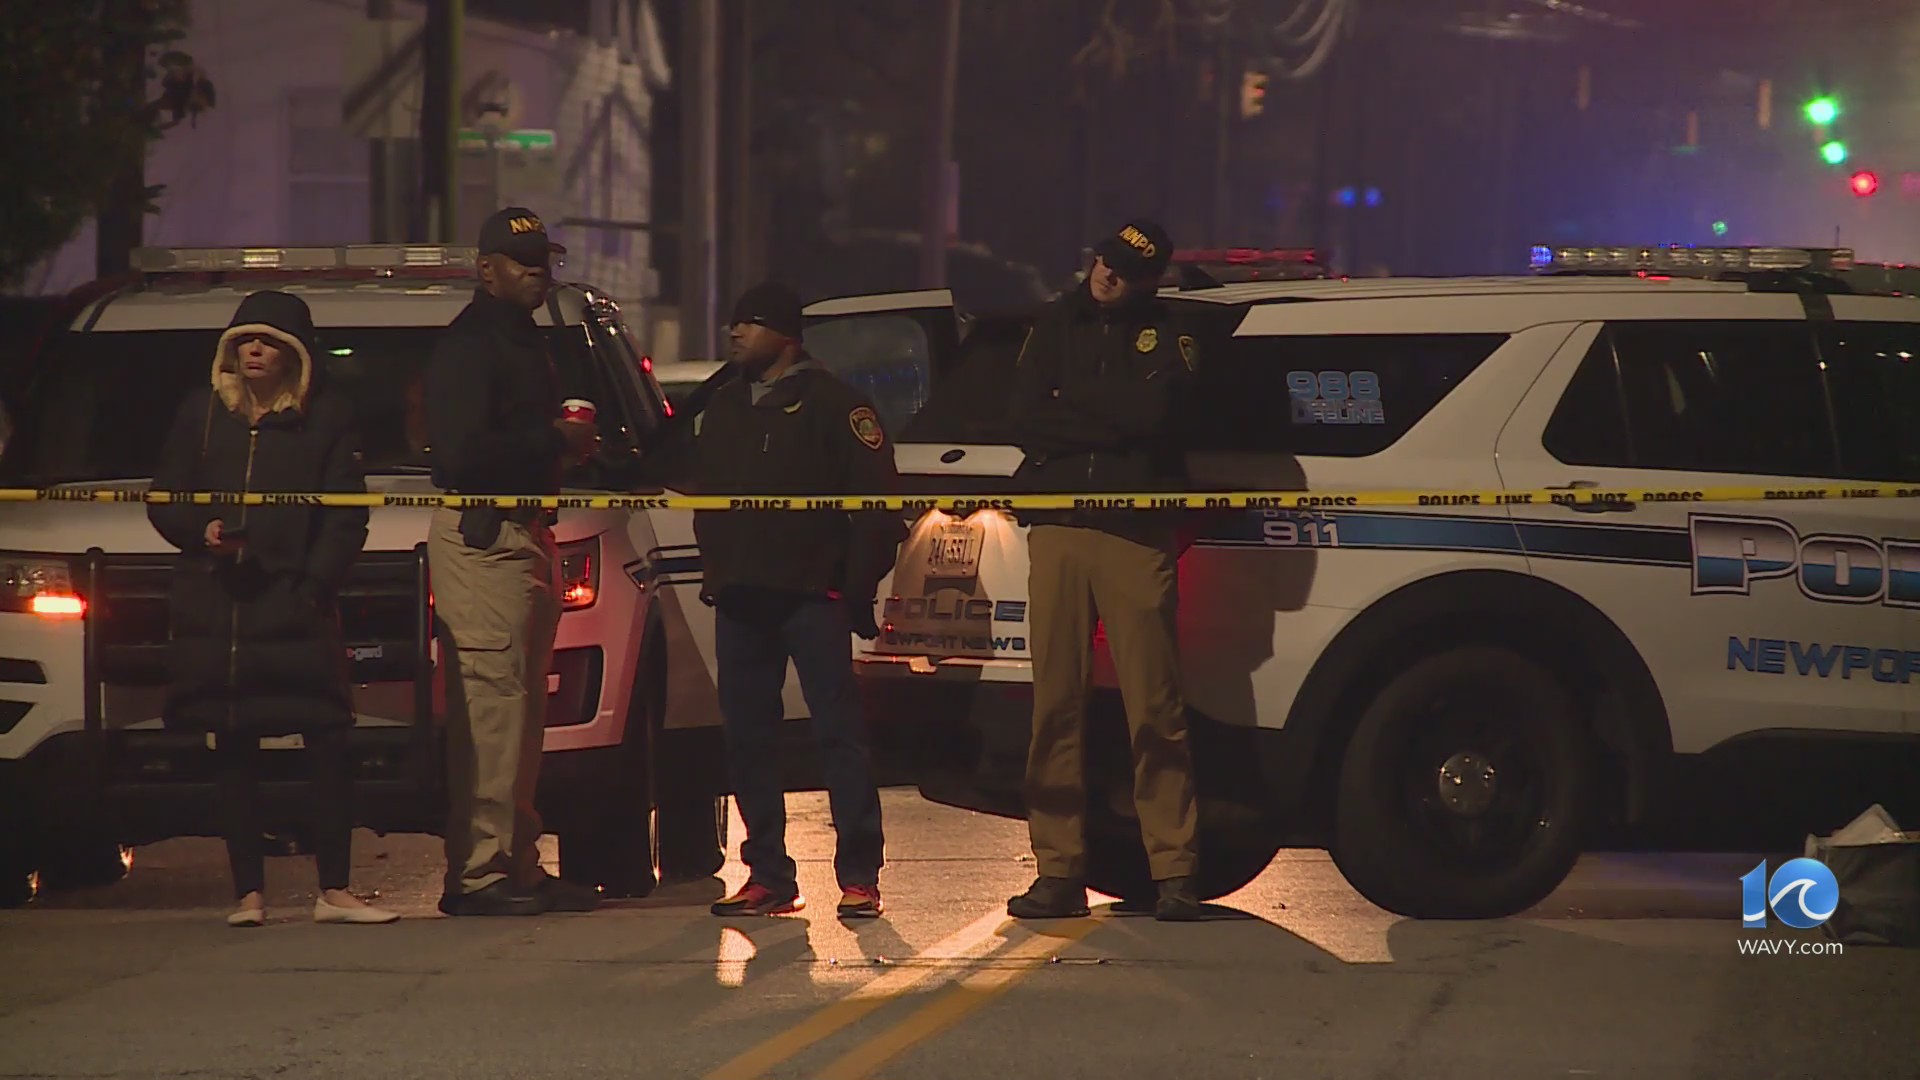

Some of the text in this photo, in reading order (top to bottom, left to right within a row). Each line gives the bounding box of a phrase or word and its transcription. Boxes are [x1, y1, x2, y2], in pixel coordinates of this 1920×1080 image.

[1118, 225, 1156, 258] NNPD
[1286, 371, 1380, 401] 988
[557, 497, 593, 508] NOT
[608, 498, 669, 509] CROSS
[730, 499, 1013, 510] POLICE LINE DO NOT CROSS
[1073, 498, 1135, 509] POLICE
[1150, 497, 1187, 508] LINE
[1205, 497, 1230, 508] DO
[1245, 497, 1282, 508] NOT
[1418, 495, 1480, 506] POLICE
[1496, 494, 1532, 504] LINE
[1263, 520, 1339, 547] 911
[883, 598, 1027, 623] POLICE
